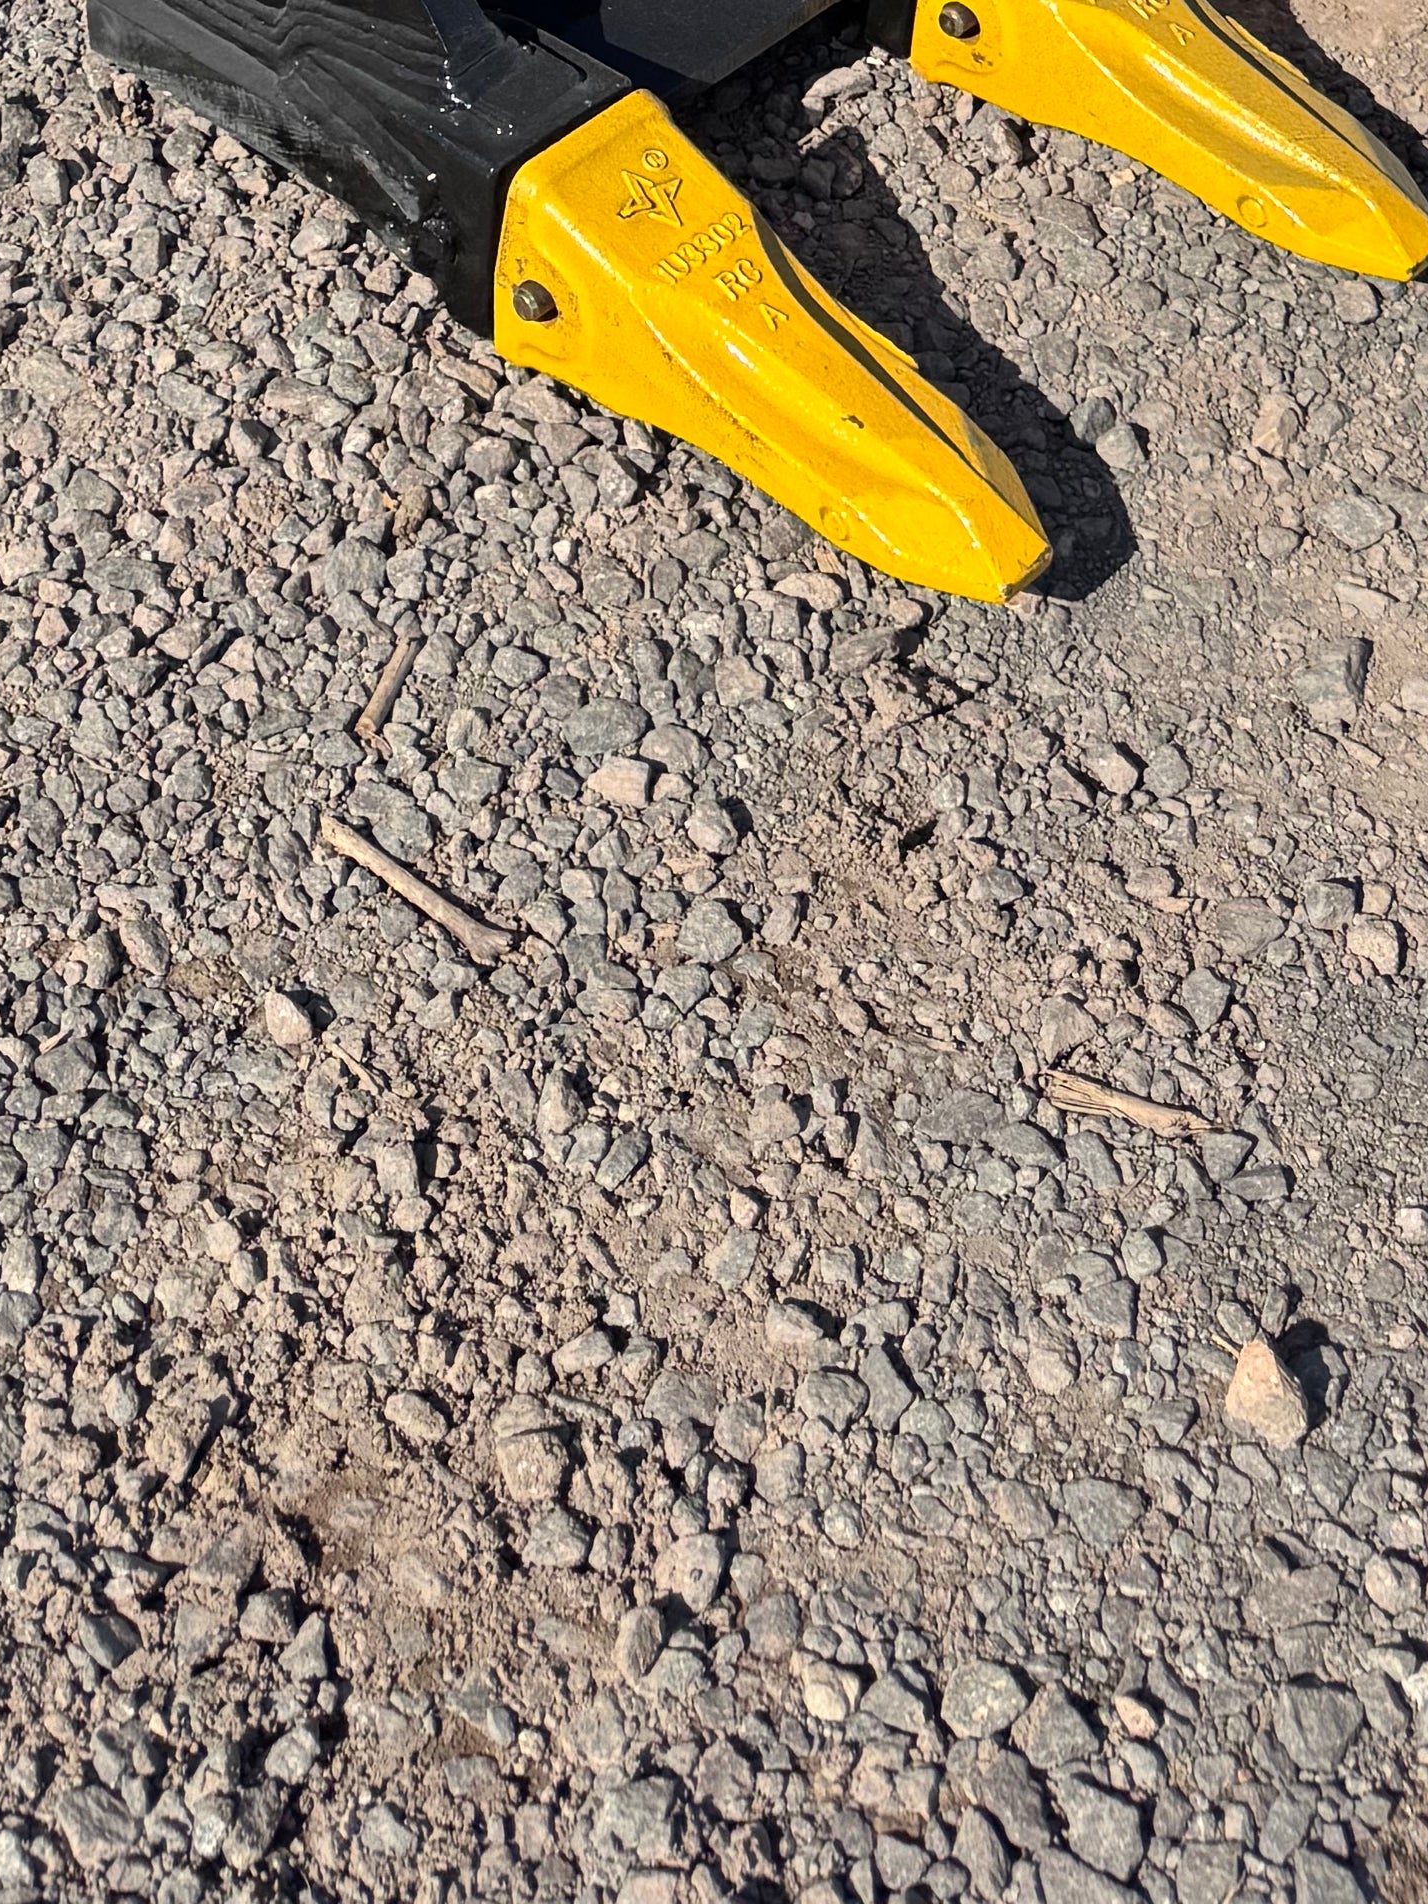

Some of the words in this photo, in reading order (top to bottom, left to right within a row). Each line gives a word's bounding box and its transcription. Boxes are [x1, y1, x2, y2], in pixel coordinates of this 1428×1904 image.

[1168, 22, 1196, 47] A
[653, 211, 753, 285] 1U3302
[713, 258, 763, 302] RC
[759, 302, 790, 332] A
